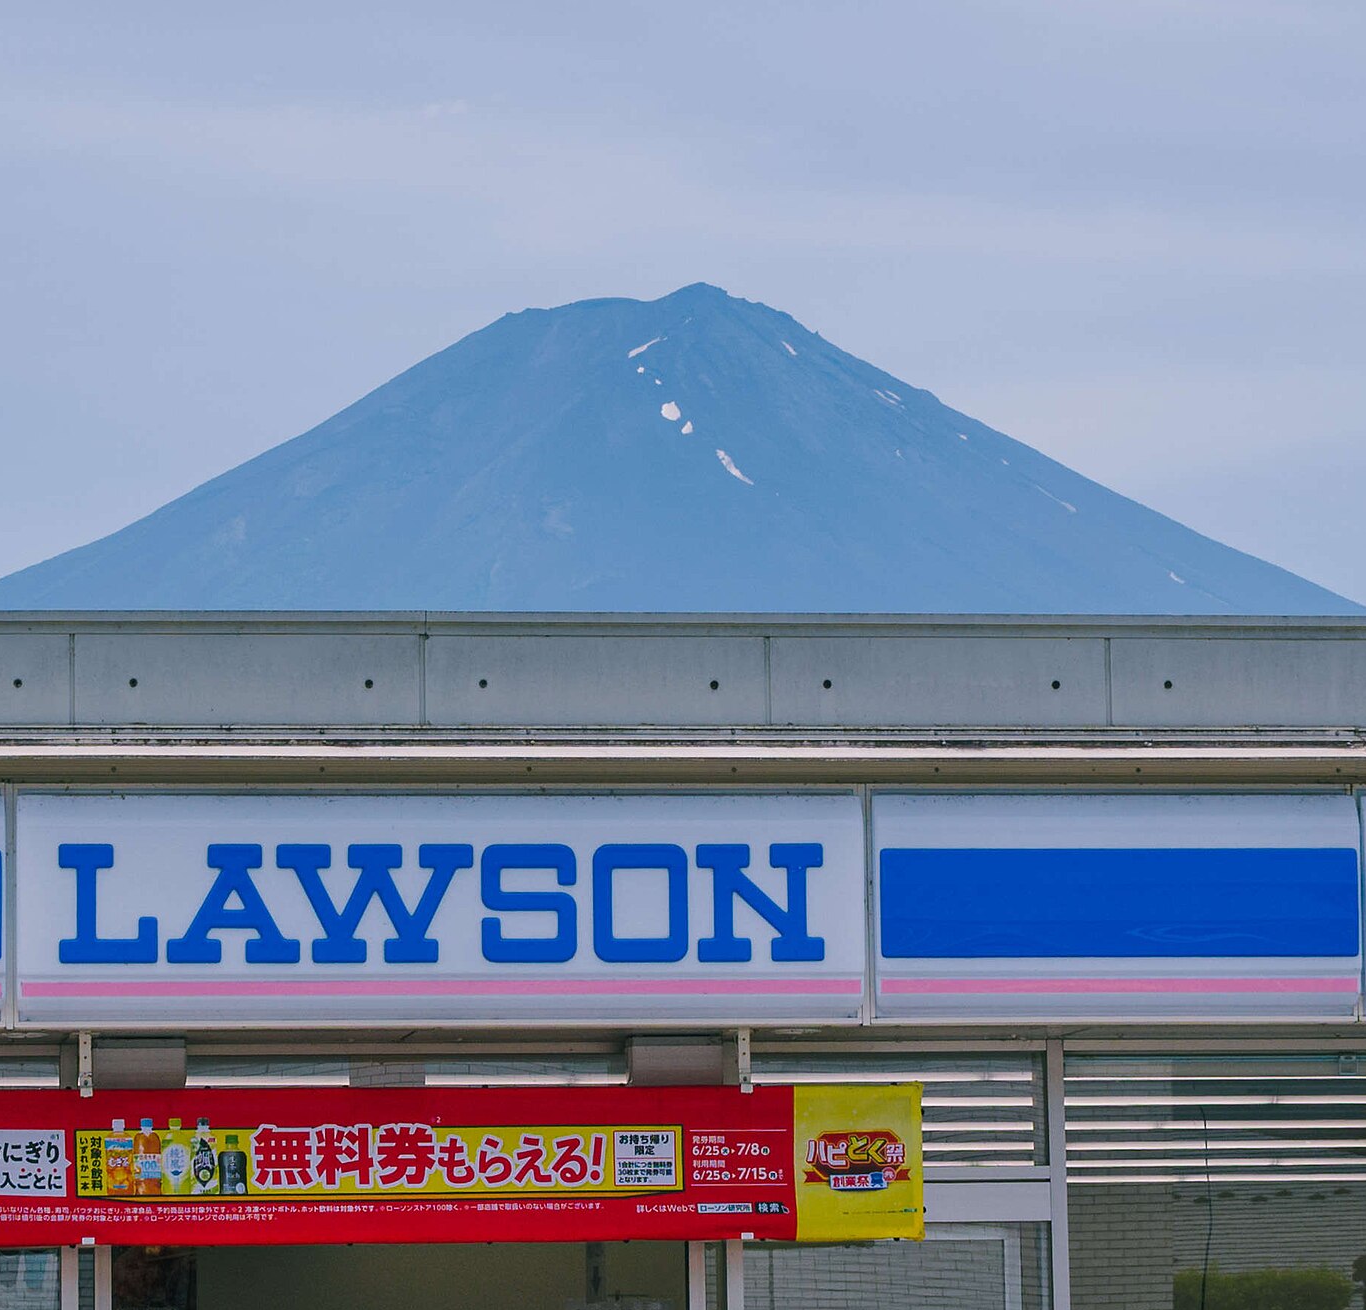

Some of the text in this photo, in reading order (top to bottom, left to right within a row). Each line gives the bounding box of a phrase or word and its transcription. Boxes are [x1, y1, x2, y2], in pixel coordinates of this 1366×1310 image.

[59, 843, 825, 964] LAWSON
[80, 1137, 89, 1190] いずれか一本
[90, 1136, 103, 1191] 対象の飲料
[619, 1134, 669, 1145] お持ち帰り
[635, 1145, 655, 1156] 限定
